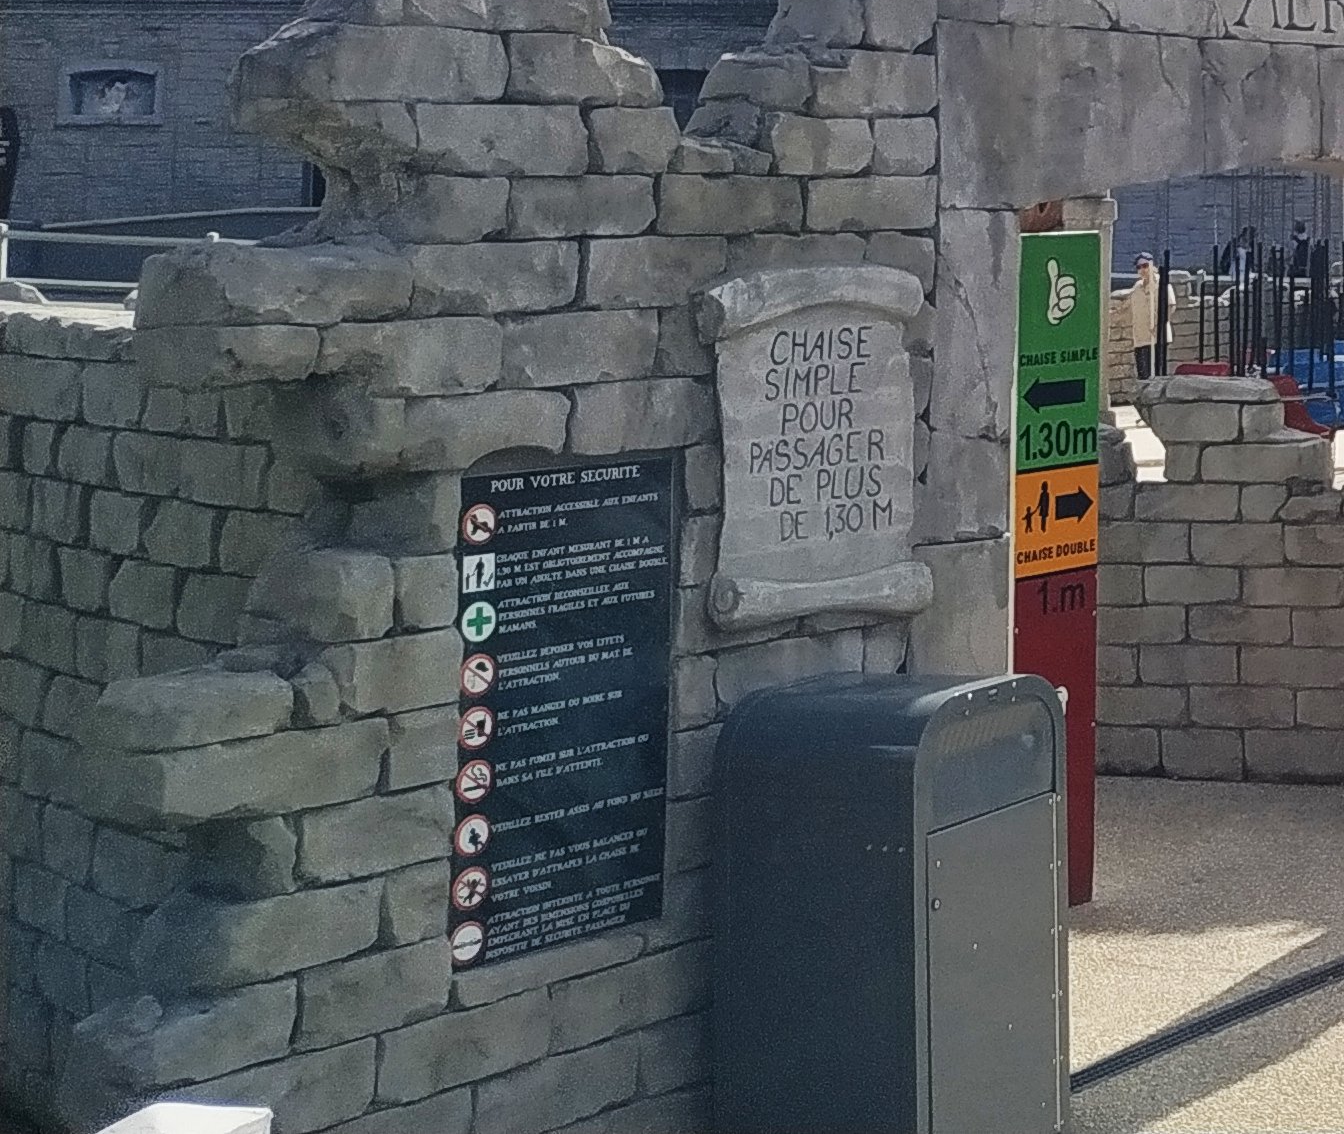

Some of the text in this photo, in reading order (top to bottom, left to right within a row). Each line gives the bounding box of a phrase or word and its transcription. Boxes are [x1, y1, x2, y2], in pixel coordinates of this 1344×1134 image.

[770, 326, 872, 365] CHAISE
[1019, 346, 1098, 365] CHAISE SIMPLE
[765, 362, 866, 401] SIMPLE
[781, 398, 853, 436] POUR
[750, 428, 885, 473] PASSAGER
[1019, 420, 1097, 461] 1.30m
[491, 465, 640, 493] POUR VOTRE SECURITE
[770, 464, 882, 507] DE PLUS
[498, 492, 658, 519] ATTRACTION ACCESSIBLE AUX ENFANTS
[508, 521, 537, 533] PARTIR
[780, 511, 808, 542] DE
[873, 498, 893, 530] M
[496, 553, 529, 563] CHAQUE
[532, 546, 565, 558] ENFANT
[568, 540, 611, 553] MESURANT
[1016, 538, 1096, 564] CHAISE DOUBLE
[496, 580, 512, 588] PAR
[530, 572, 562, 584] ADULTE
[566, 568, 587, 578] DANS
[589, 565, 606, 574] UNE
[524, 562, 539, 571] EST
[497, 593, 551, 609] ATTRACTION
[612, 581, 629, 591] AUX
[1038, 580, 1086, 616] 1.m
[577, 639, 593, 649] VOS
[553, 655, 586, 668] AUTOUR
[512, 707, 528, 718] PAS
[510, 759, 527, 769] PAS
[534, 809, 565, 824] RESTER
